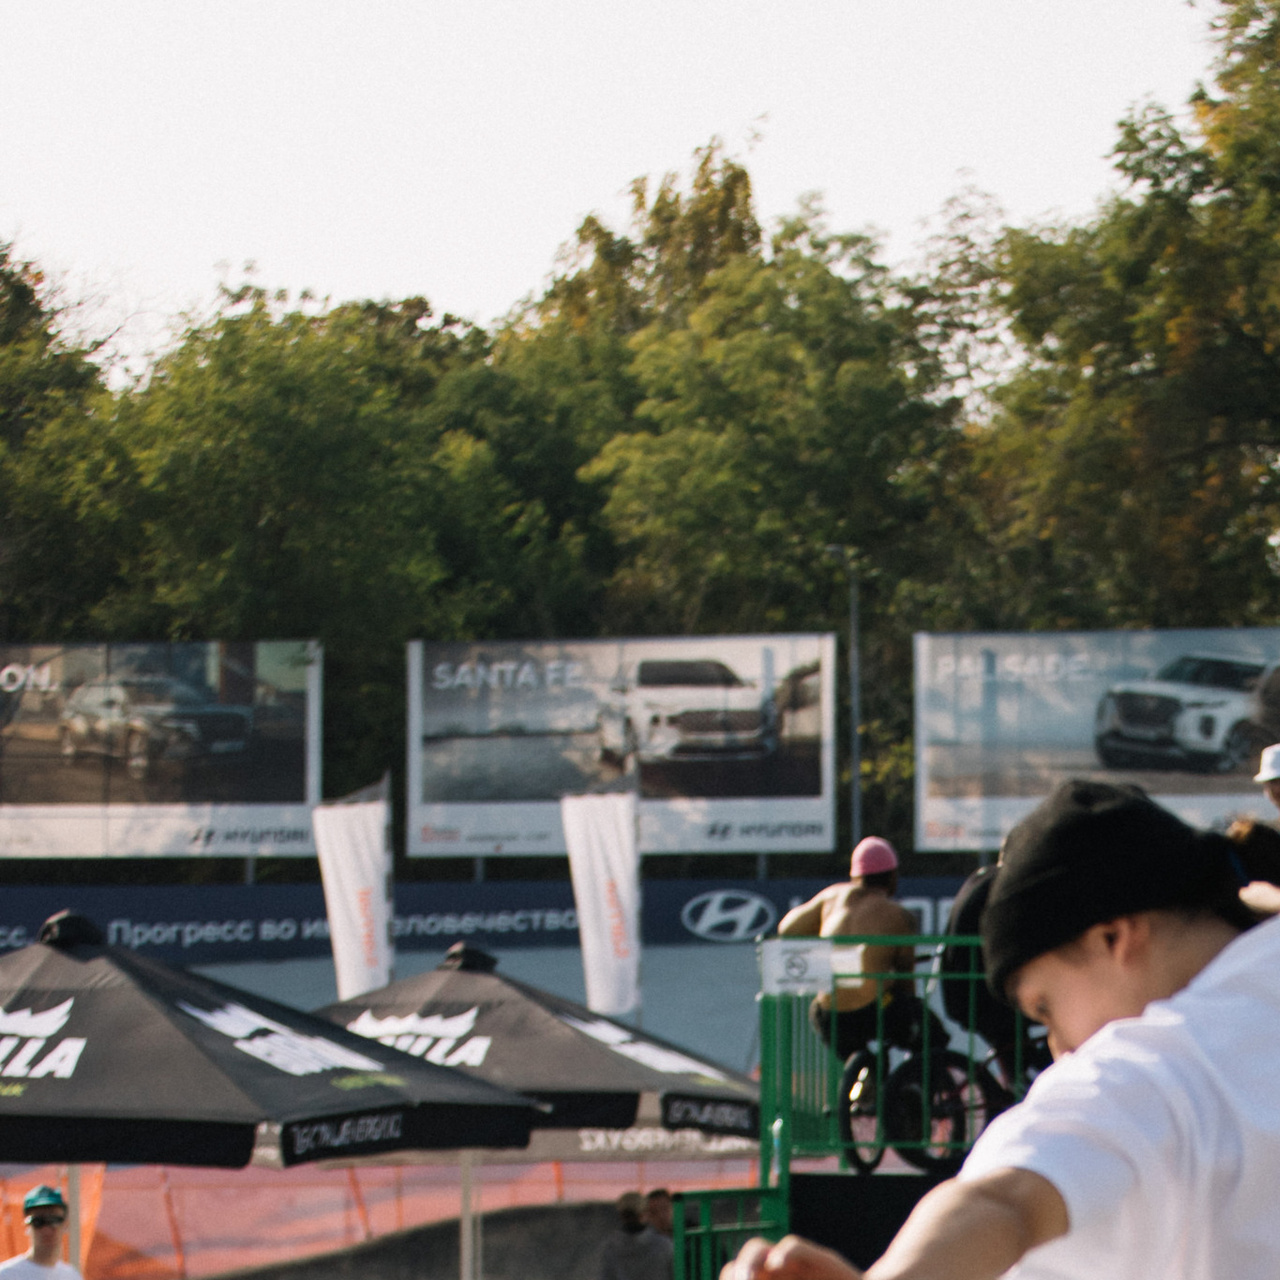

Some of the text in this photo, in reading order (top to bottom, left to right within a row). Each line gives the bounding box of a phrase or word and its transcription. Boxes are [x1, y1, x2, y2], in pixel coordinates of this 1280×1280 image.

[433, 661, 538, 690] SANTA
[107, 918, 253, 948] Прогресс
[259, 919, 297, 941] во
